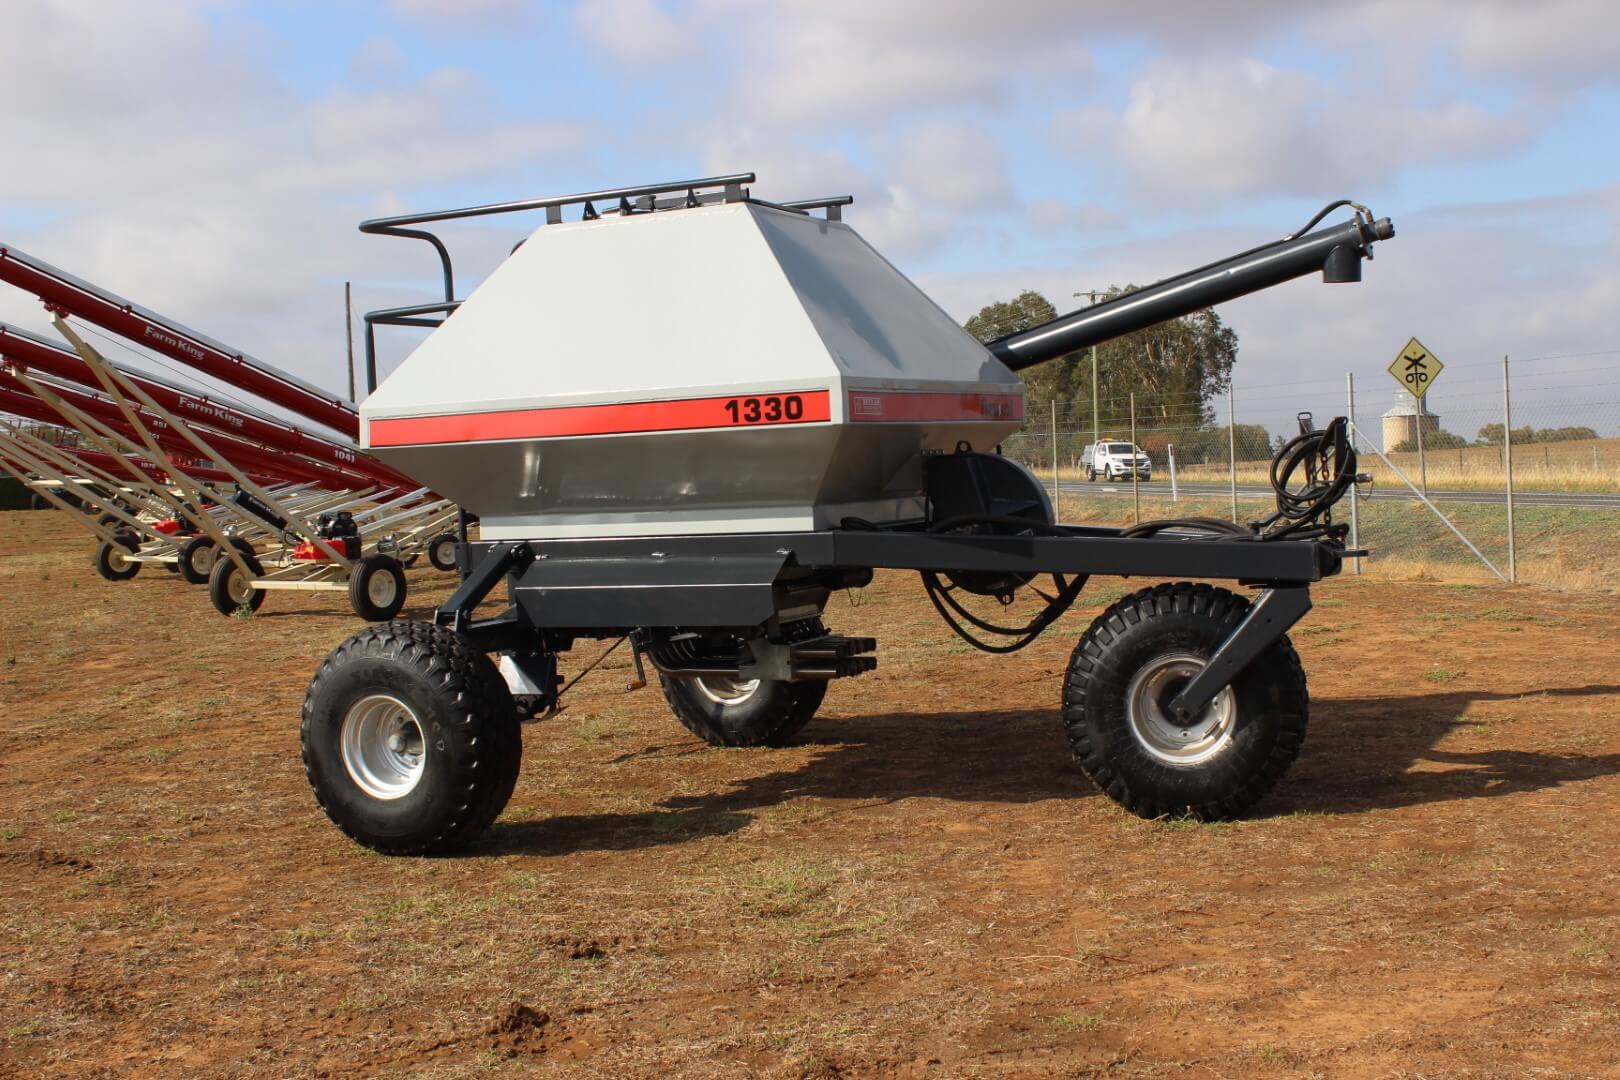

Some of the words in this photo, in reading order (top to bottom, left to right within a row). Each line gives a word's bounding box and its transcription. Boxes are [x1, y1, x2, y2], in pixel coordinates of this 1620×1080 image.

[145, 326, 177, 346] Farm
[177, 341, 205, 360] King
[179, 397, 213, 415] Farm
[214, 410, 244, 427] King
[724, 395, 803, 423] 1330
[334, 450, 355, 463] 1041
